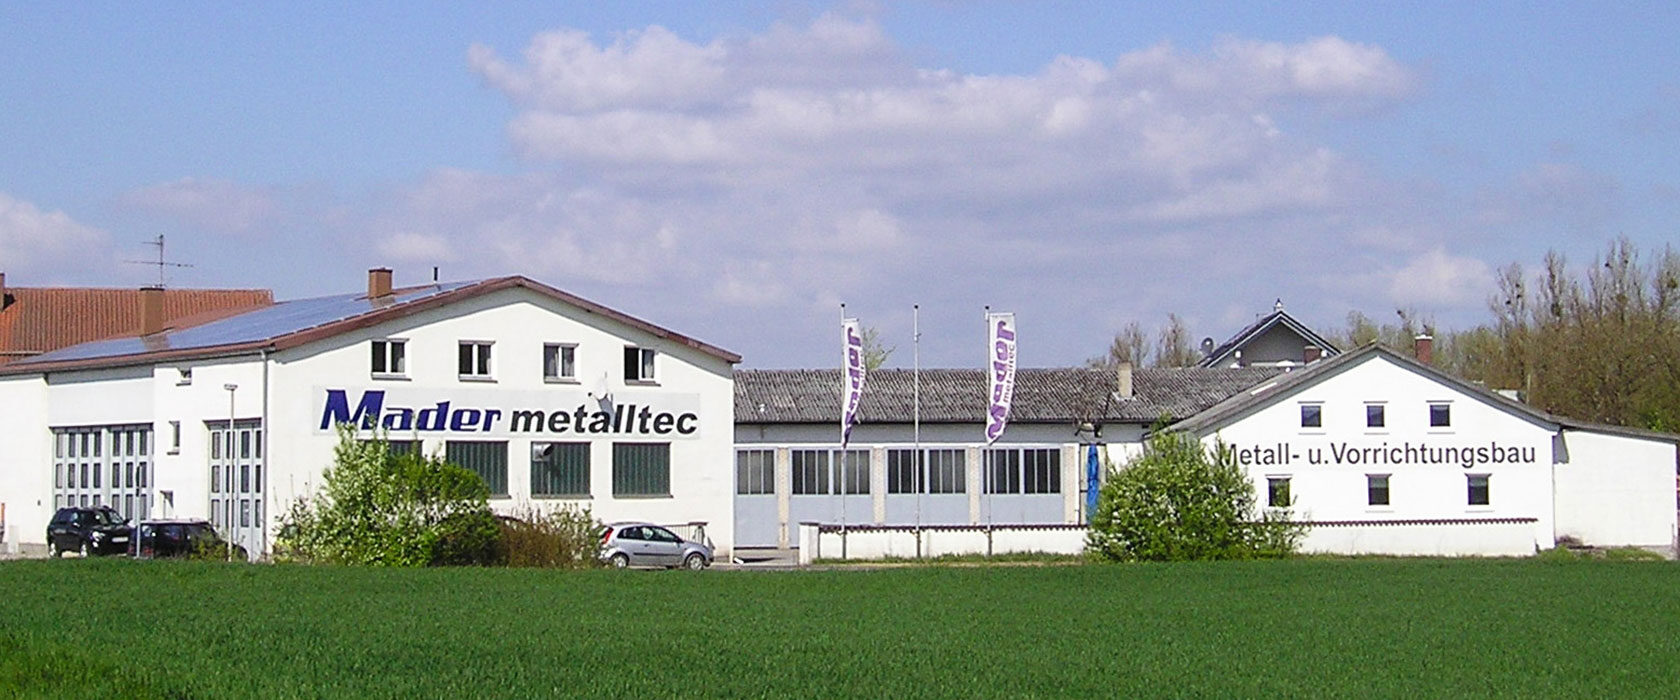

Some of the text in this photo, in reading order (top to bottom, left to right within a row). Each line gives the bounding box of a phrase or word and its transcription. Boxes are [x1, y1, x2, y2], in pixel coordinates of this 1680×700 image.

[320, 389, 698, 434] Mader metalltec
[988, 320, 1015, 439] Mader
